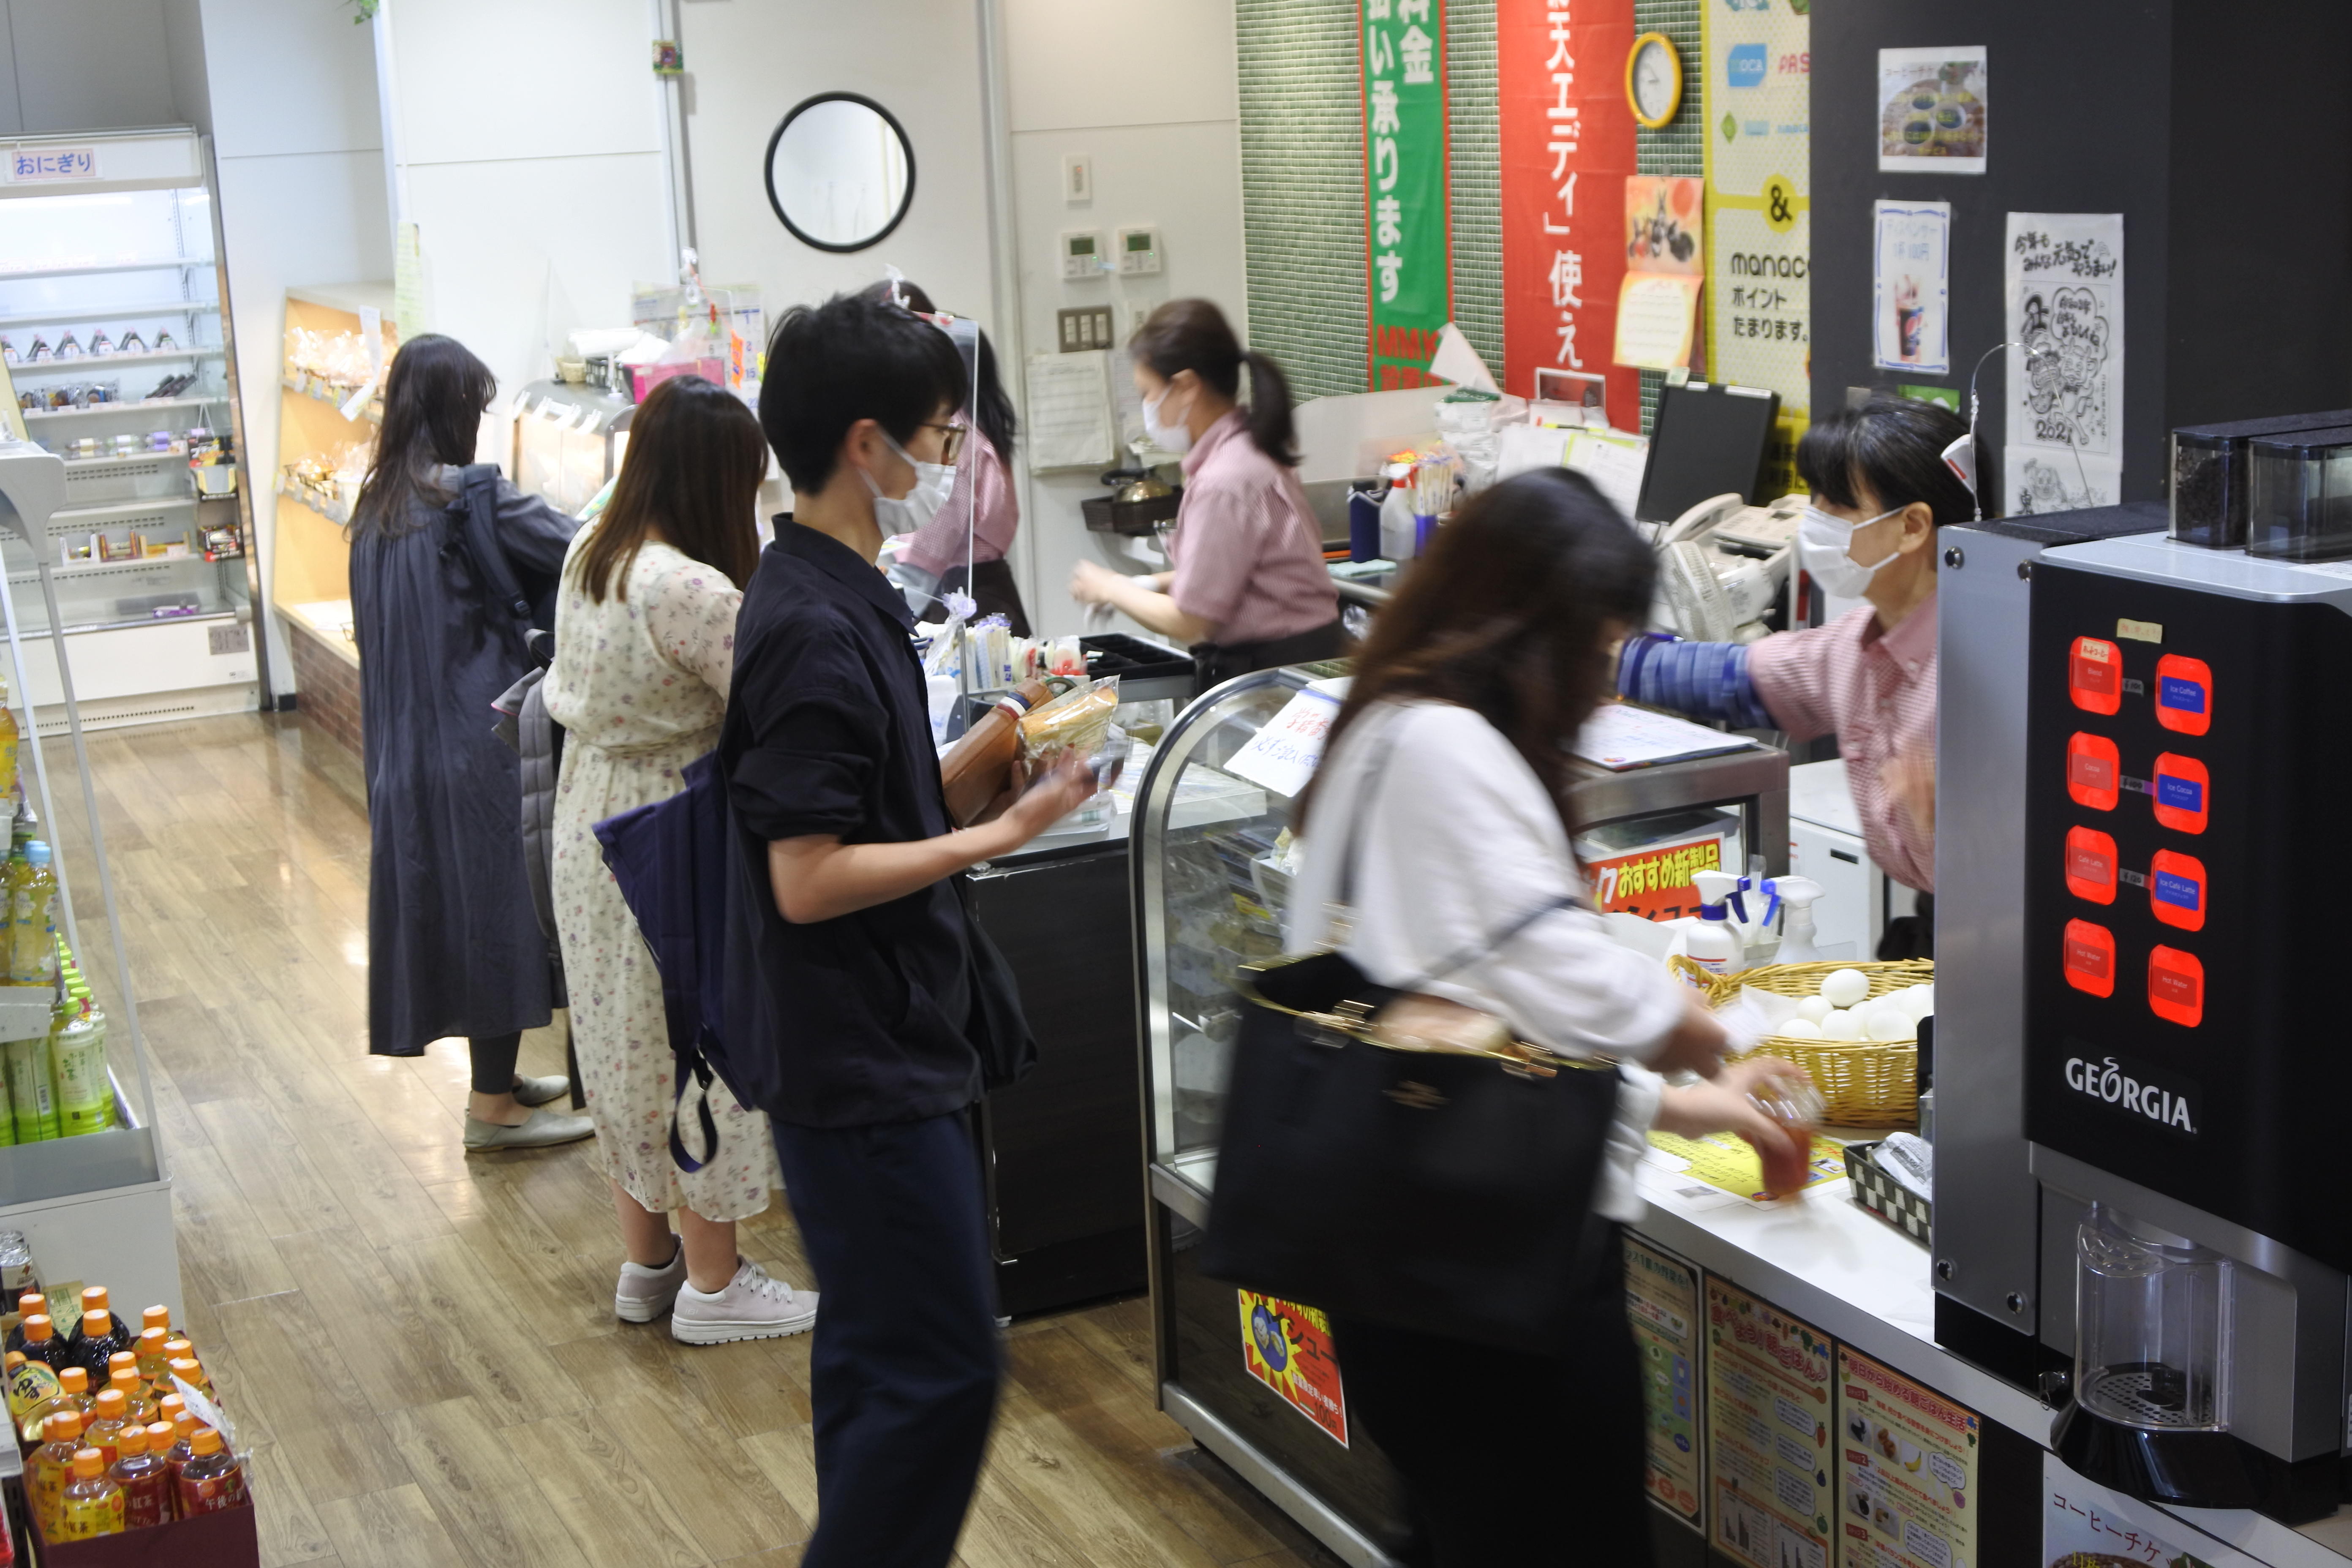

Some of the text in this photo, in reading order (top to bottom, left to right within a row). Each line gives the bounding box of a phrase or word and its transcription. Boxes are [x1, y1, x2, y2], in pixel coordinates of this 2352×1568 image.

[16, 152, 90, 175] おにぎり
[1731, 252, 1810, 278] manac
[1733, 286, 1787, 310] ポイント
[1734, 316, 1808, 341] たまります。
[1376, 324, 1440, 362] MMK
[2179, 686, 2196, 697] Coffee
[2085, 763, 2100, 773] Cocoa
[2167, 783, 2192, 795] Ice Cocoa
[2159, 878, 2167, 887] Ice
[2182, 883, 2196, 894] Latte
[2087, 952, 2101, 961] Water
[2162, 975, 2188, 989] Hot Water
[2066, 1057, 2192, 1132] GEORGIA
[13, 1378, 40, 1401] ゆず
[1848, 1357, 1967, 1434] 明日から始める朝ごはん生活
[1314, 1401, 1338, 1432] 100円
